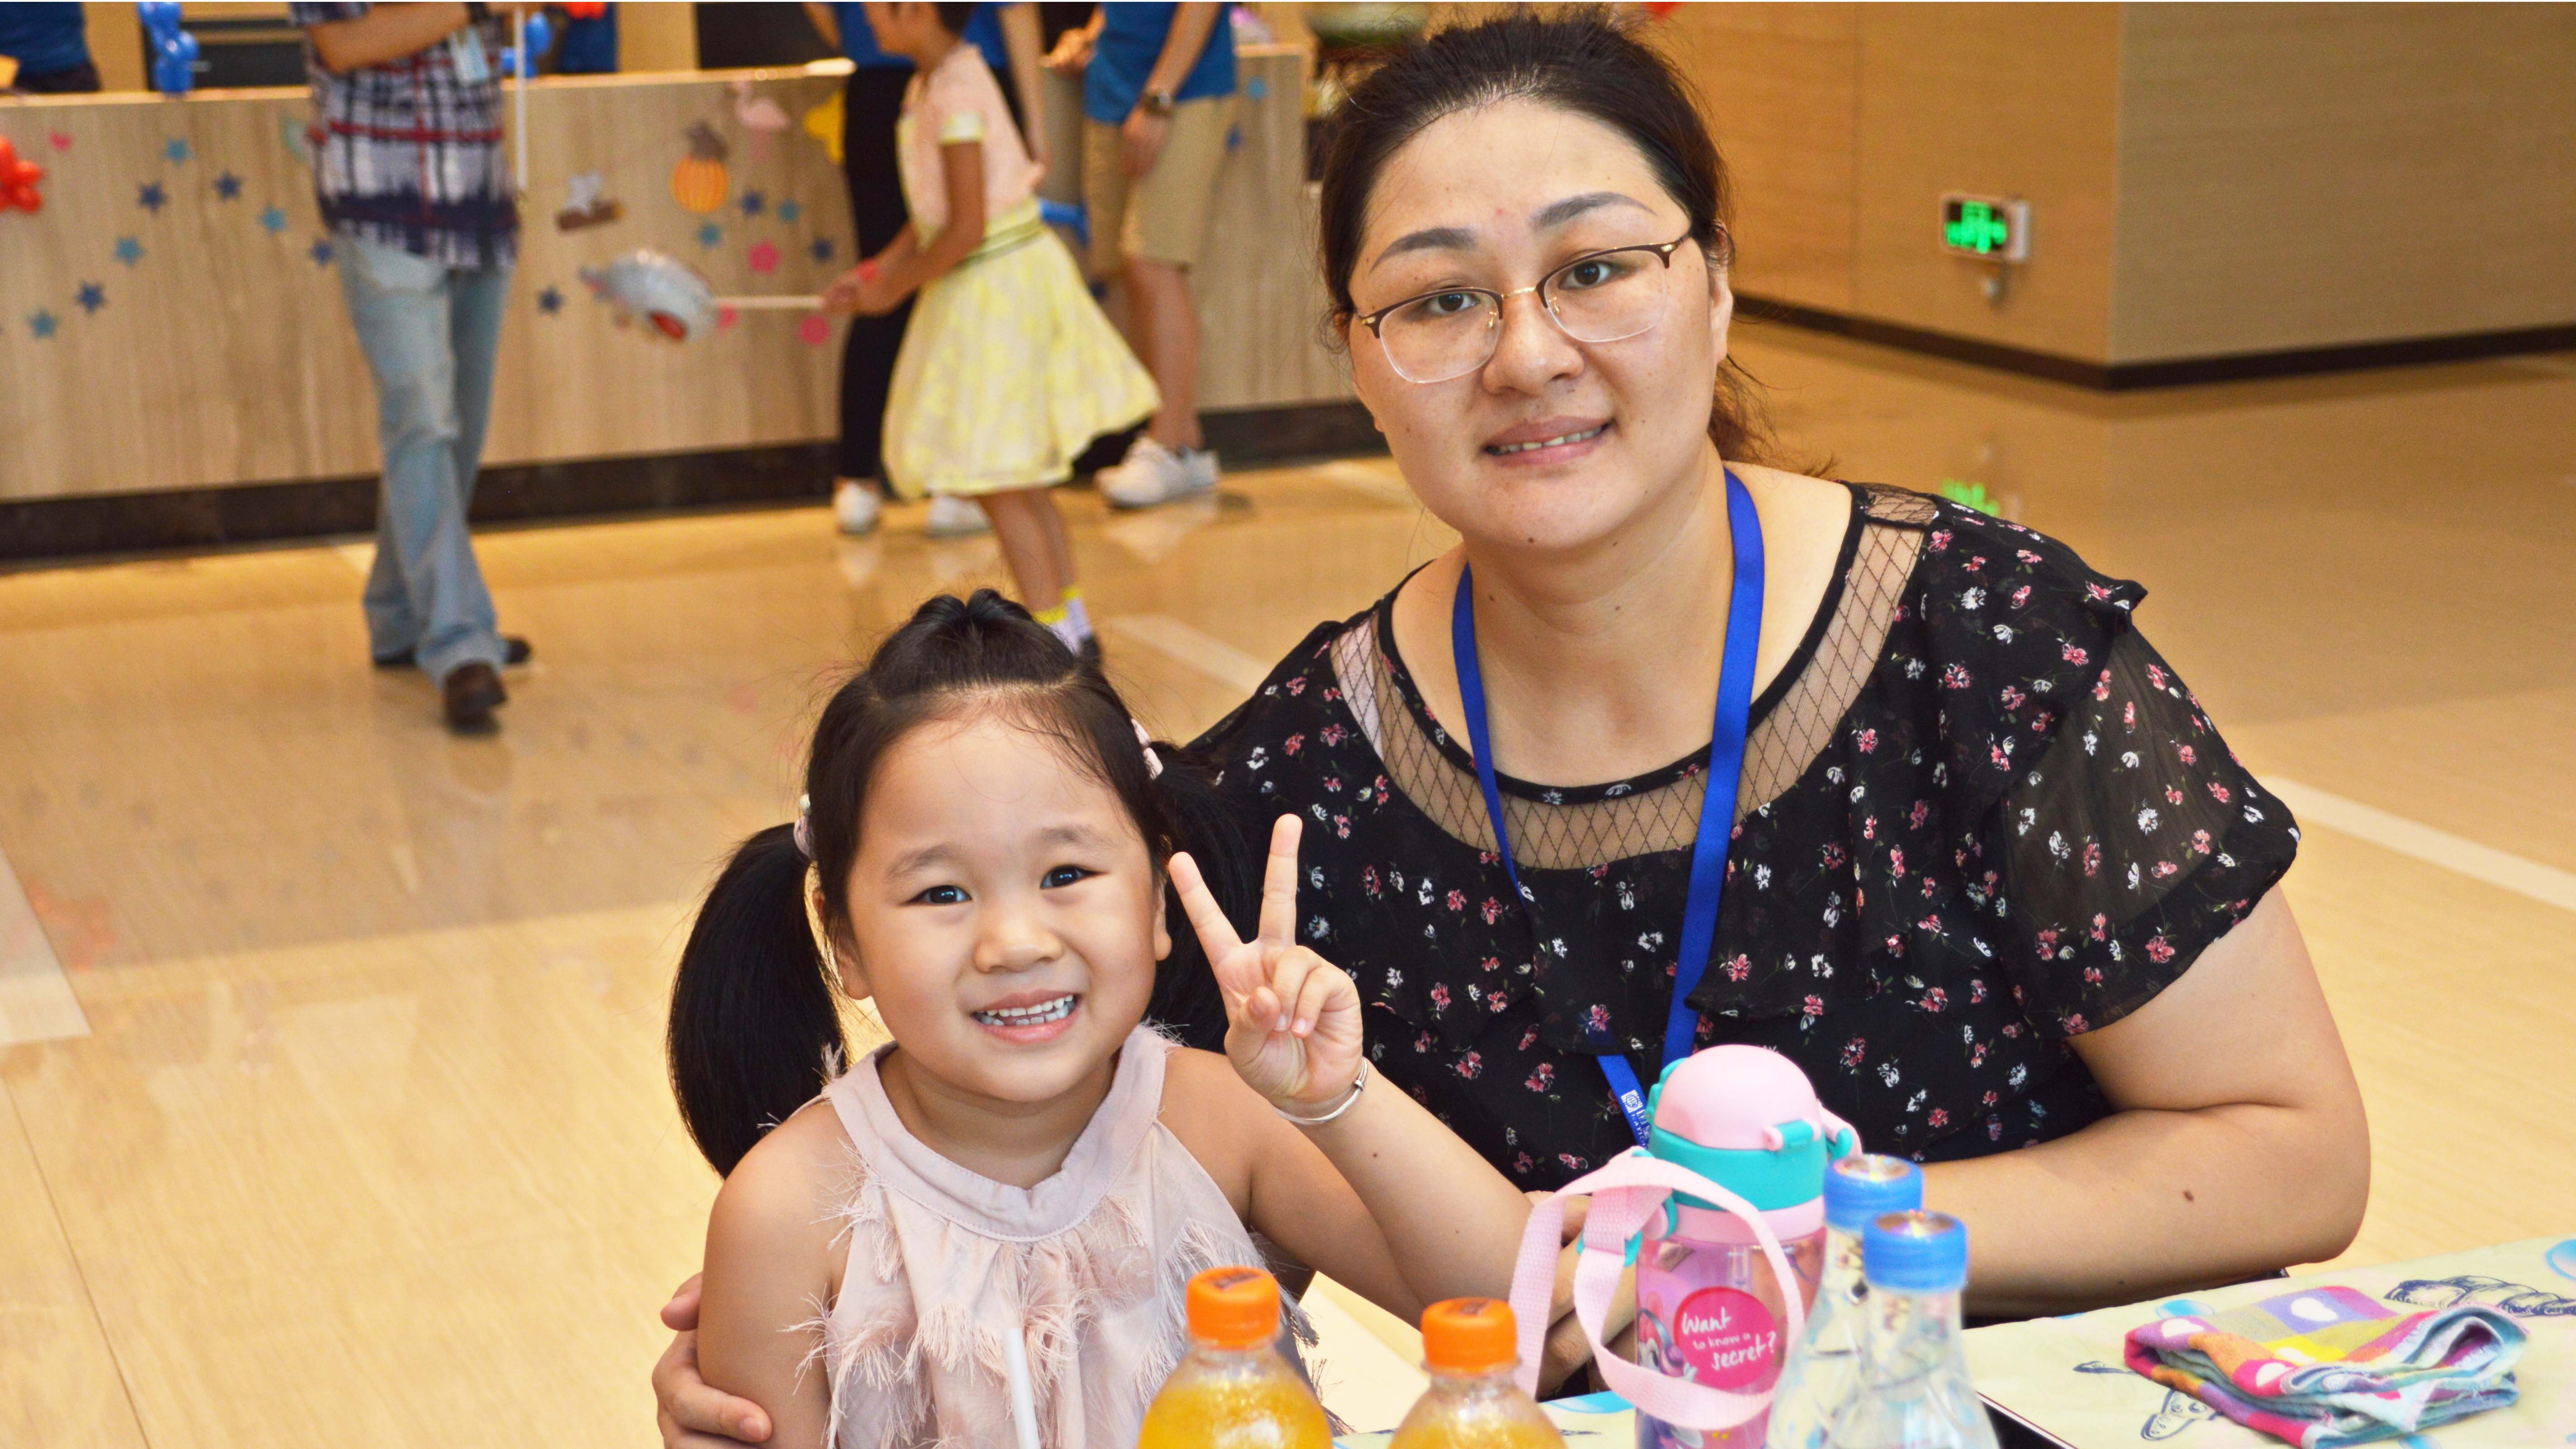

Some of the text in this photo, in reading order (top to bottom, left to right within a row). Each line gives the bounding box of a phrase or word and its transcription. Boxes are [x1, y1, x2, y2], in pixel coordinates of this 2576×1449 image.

[1682, 1306, 1731, 1335] Want
[1693, 1340, 1706, 1350] to
[1708, 1336, 1740, 1348] know
[1712, 1331, 1776, 1370] secret?
